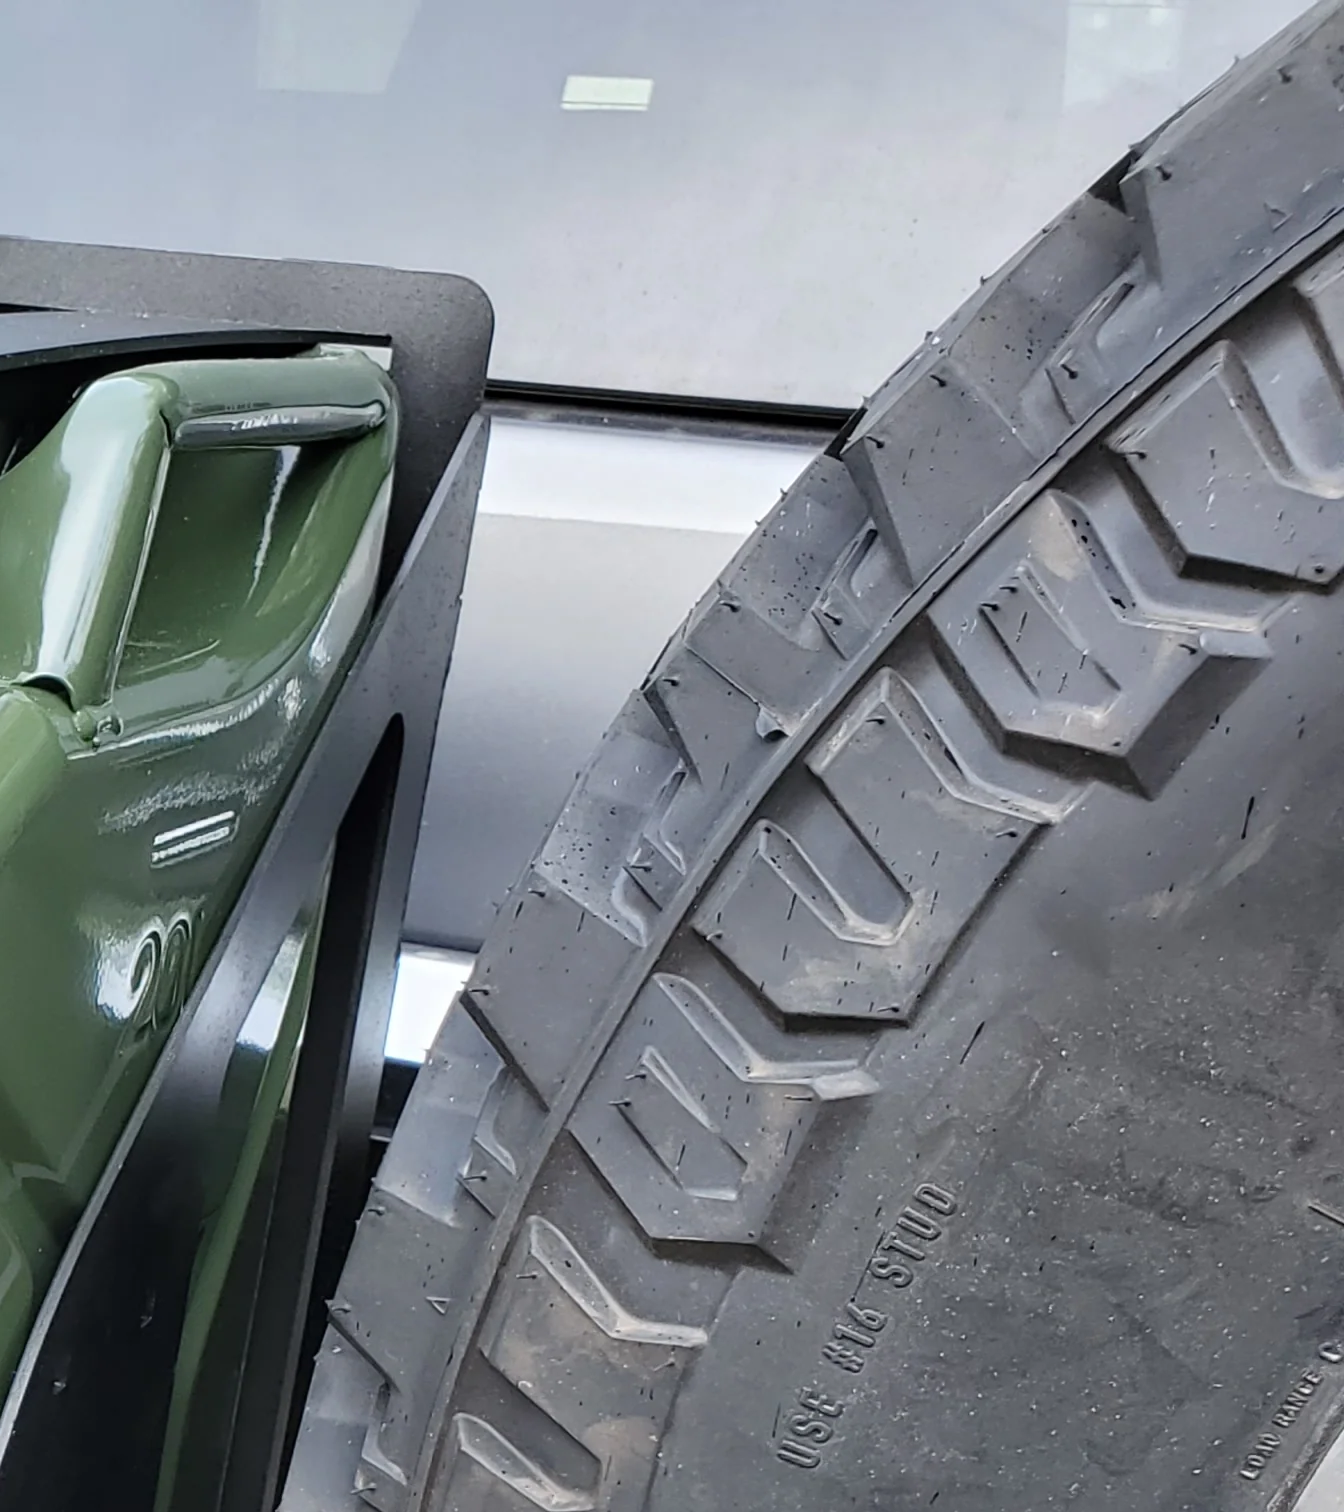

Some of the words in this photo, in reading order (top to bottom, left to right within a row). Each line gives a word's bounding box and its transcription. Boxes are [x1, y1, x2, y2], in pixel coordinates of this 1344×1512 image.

[776, 1386, 844, 1468] USE
[823, 1302, 888, 1373] #16
[869, 1183, 958, 1288] STUD
[1240, 1432, 1281, 1480] LOAD
[1272, 1368, 1324, 1428] RANGE
